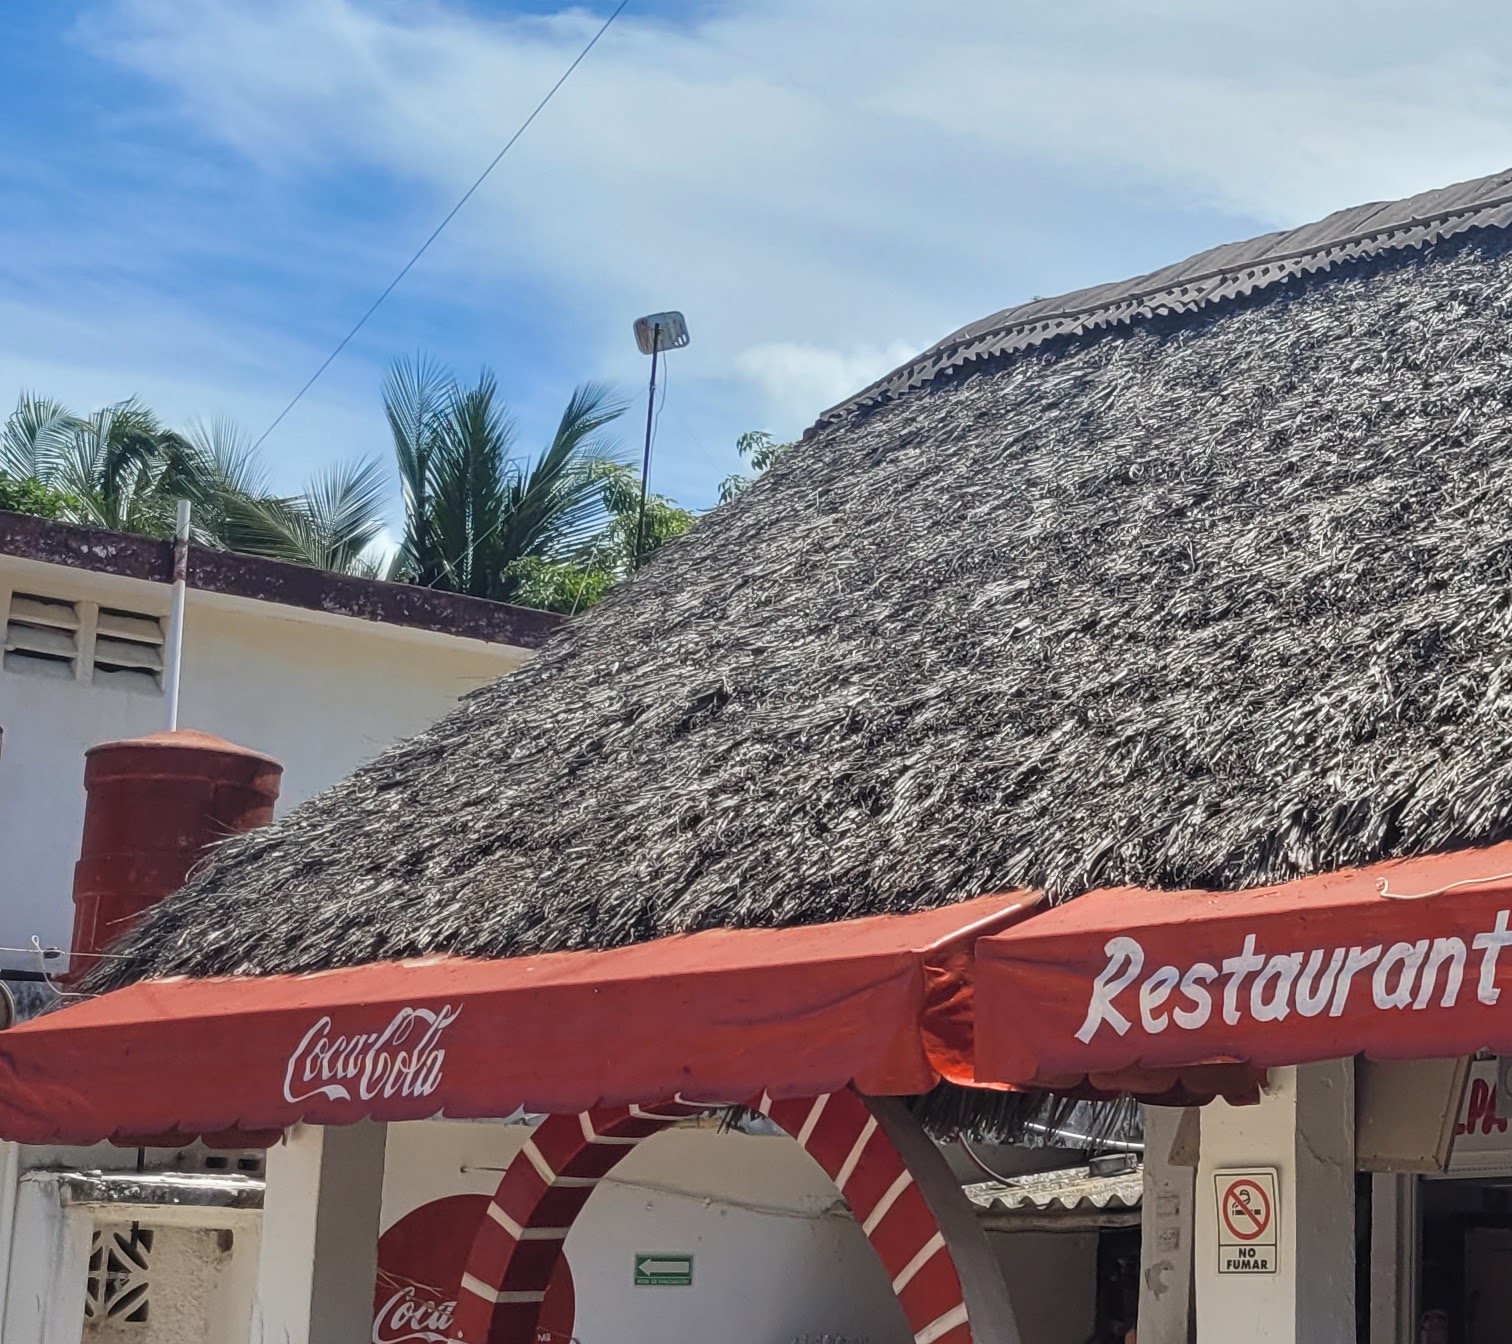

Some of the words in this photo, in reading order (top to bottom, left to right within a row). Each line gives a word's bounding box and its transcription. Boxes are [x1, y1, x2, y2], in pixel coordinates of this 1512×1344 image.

[284, 1003, 463, 1103] Coca-Cola
[1238, 1248, 1256, 1258] NO
[1226, 1259, 1268, 1270] FUMAR
